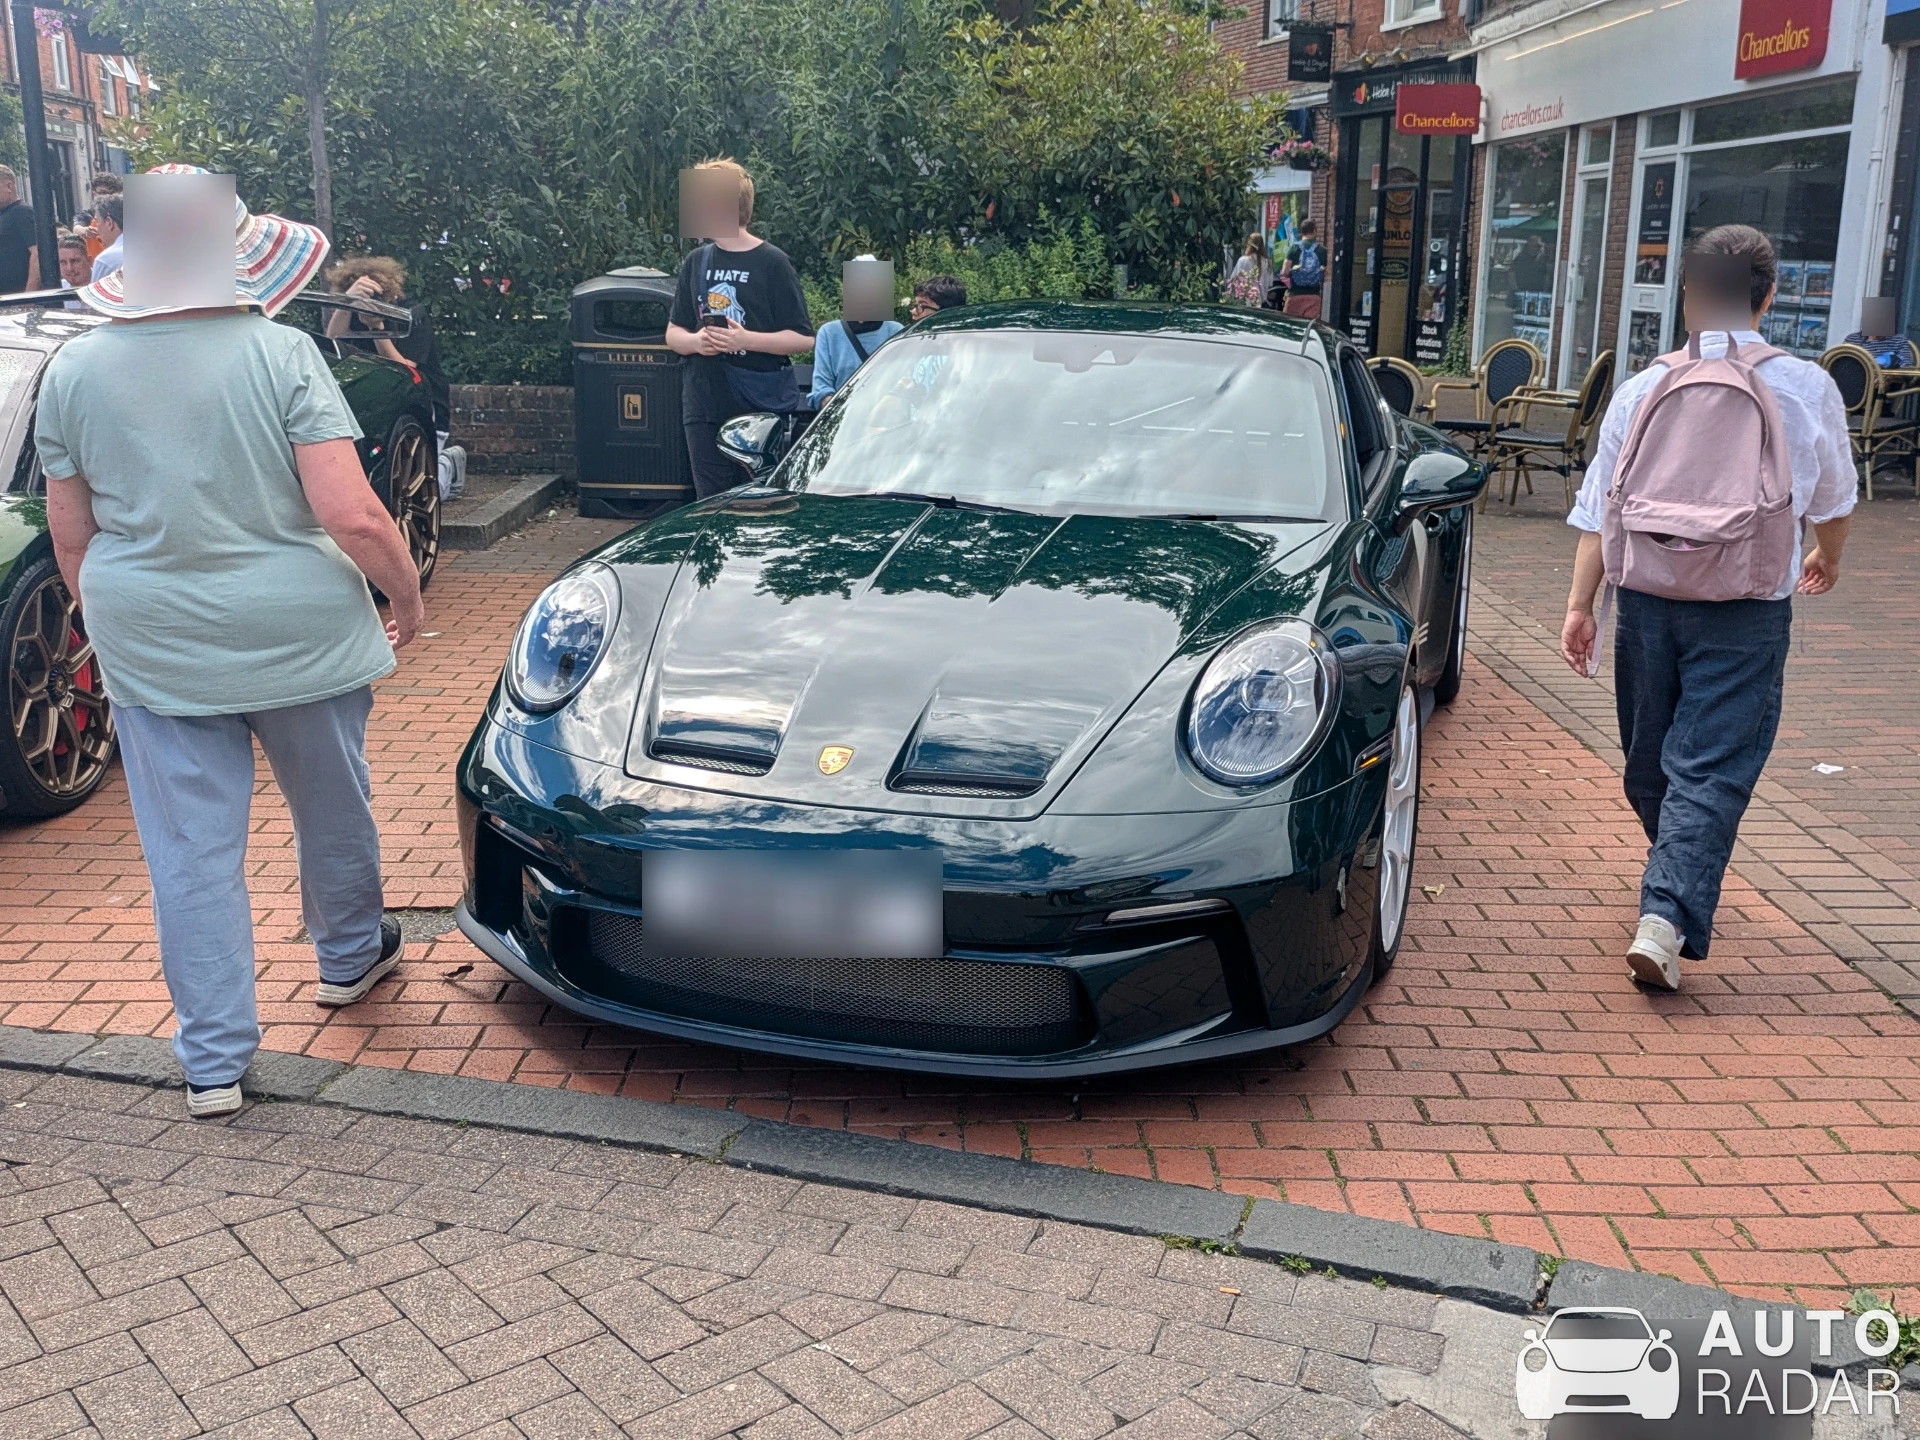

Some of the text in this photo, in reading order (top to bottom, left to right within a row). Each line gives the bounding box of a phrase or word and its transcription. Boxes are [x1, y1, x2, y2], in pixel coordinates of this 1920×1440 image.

[1740, 19, 1810, 62] Chancellors
[1371, 82, 1389, 99] Helen
[1402, 112, 1475, 128] Chancellors
[1501, 95, 1563, 131] chancellors.co.uk
[706, 269, 750, 283] I HATE
[1422, 324, 1438, 335] Stock
[1415, 336, 1442, 349] donations
[608, 353, 654, 363] LITTER
[1416, 350, 1440, 360] welcome
